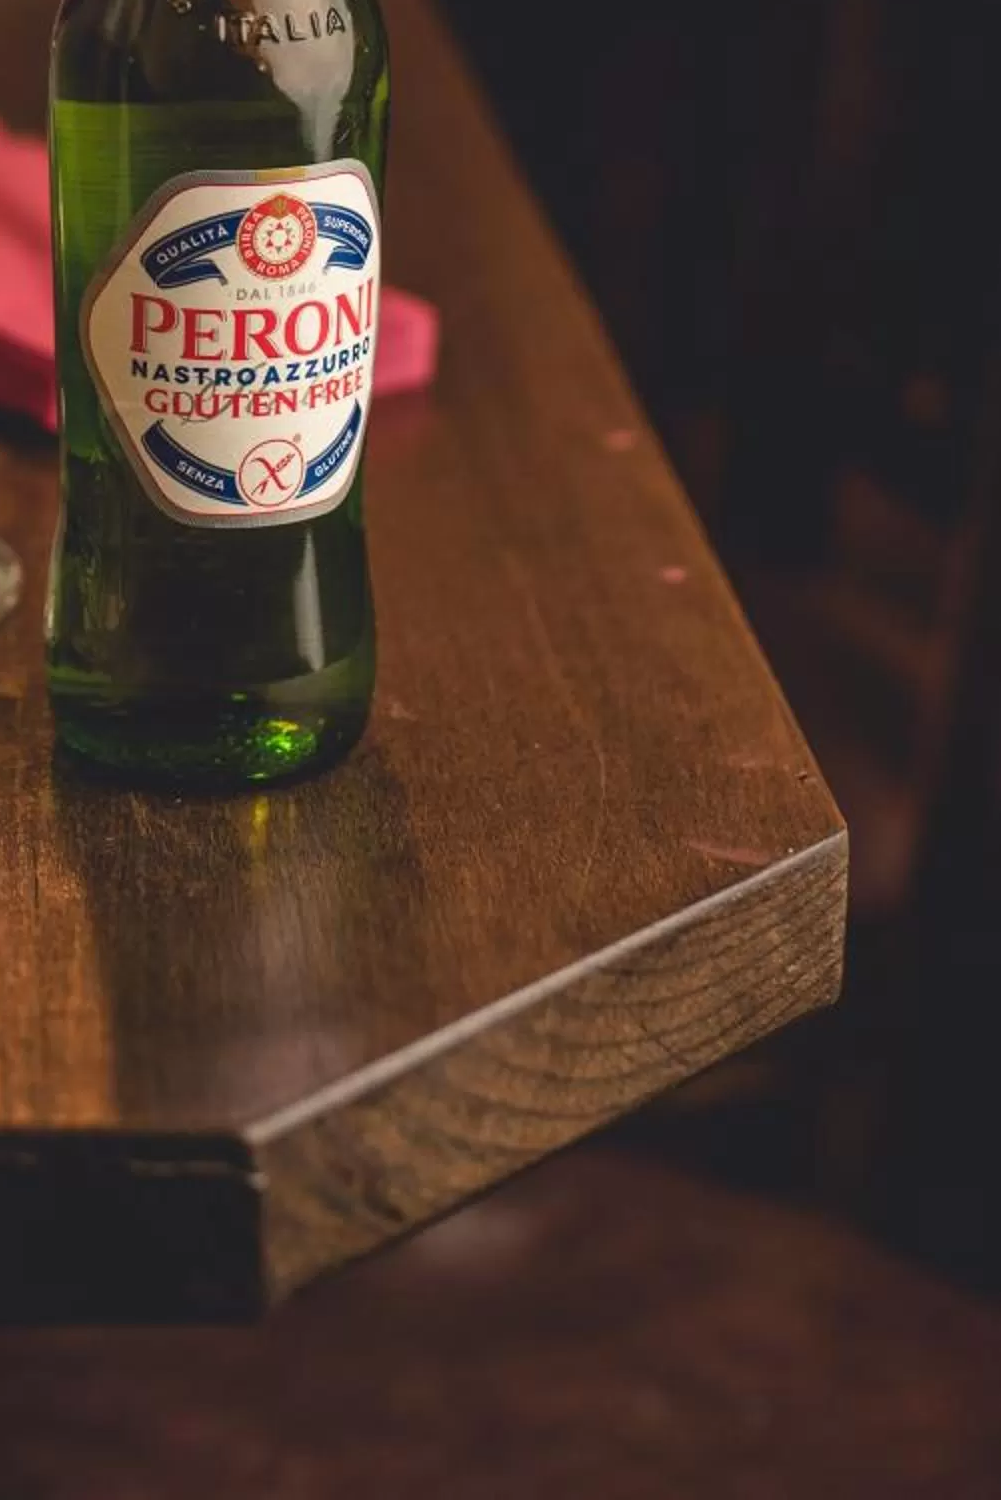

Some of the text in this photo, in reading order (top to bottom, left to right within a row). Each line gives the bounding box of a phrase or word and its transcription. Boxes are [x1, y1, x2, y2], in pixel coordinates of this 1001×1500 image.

[215, 7, 346, 45] ITALIA
[256, 259, 300, 277] ROMA
[236, 287, 272, 302] DAL
[129, 278, 374, 362] PERONI
[144, 387, 298, 421] GLUTEN
[307, 366, 365, 410] FREE
[175, 458, 226, 492] SENZA
